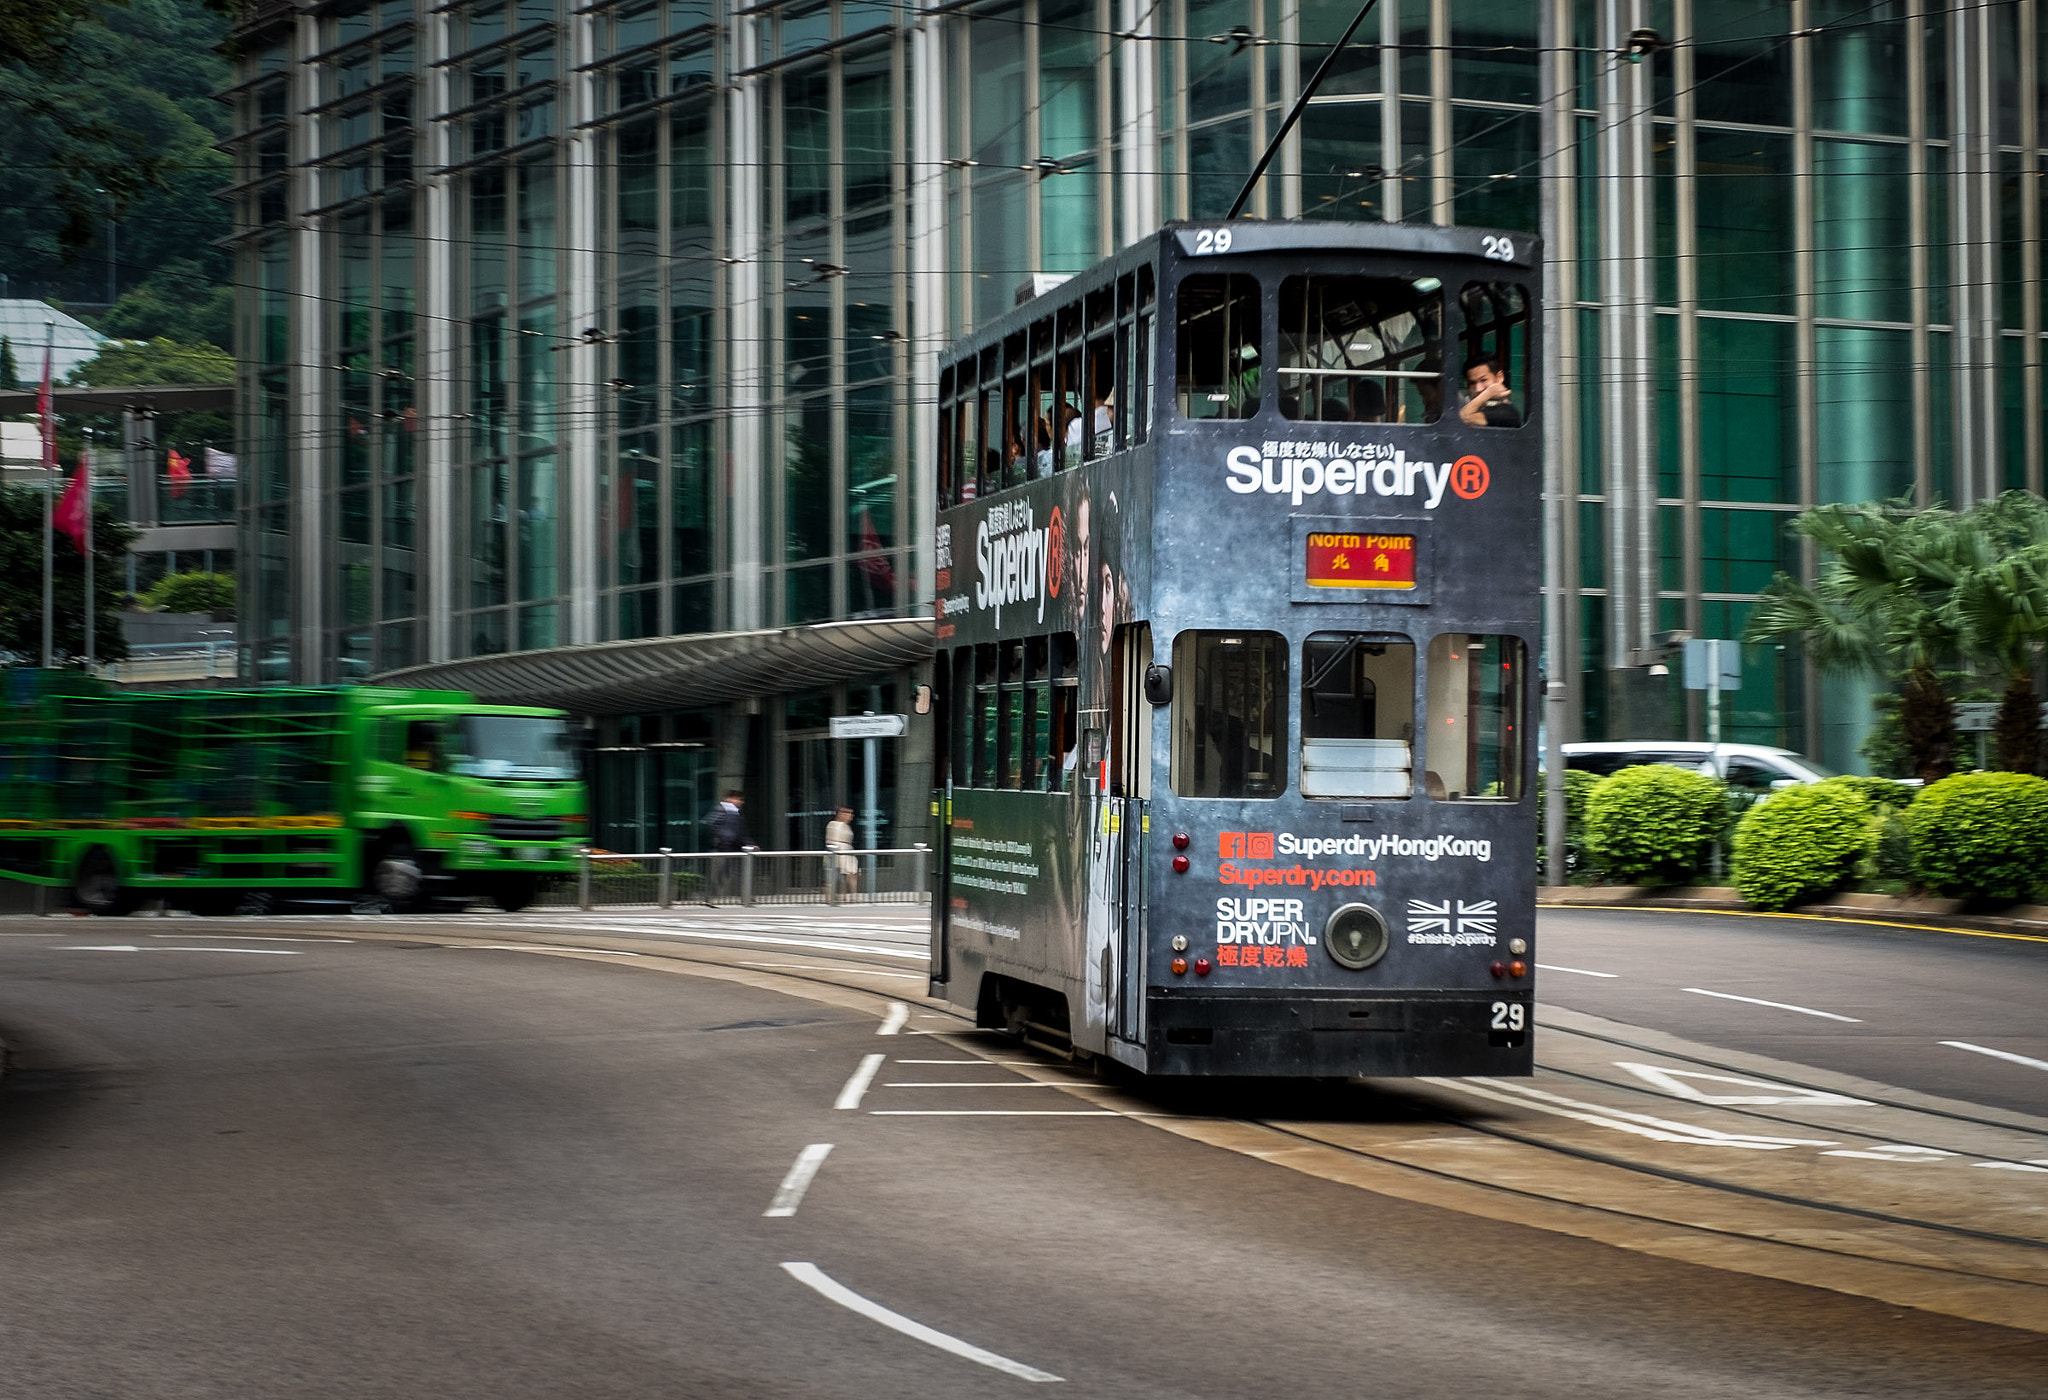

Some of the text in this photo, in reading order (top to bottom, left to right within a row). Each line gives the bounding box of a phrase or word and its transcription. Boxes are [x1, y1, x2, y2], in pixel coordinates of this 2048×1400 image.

[1196, 228, 1232, 255] 29
[1481, 235, 1515, 262] 29
[1226, 445, 1452, 509] Superdry
[1309, 534, 1412, 550] North Point
[975, 507, 1050, 630] Superdry
[1278, 832, 1492, 862] SuperdryHongKong
[1219, 863, 1377, 891] Superdry.com
[1216, 897, 1304, 921] SUPER
[1217, 945, 1308, 968] 極度乾燥
[1491, 1001, 1525, 1031] 29
